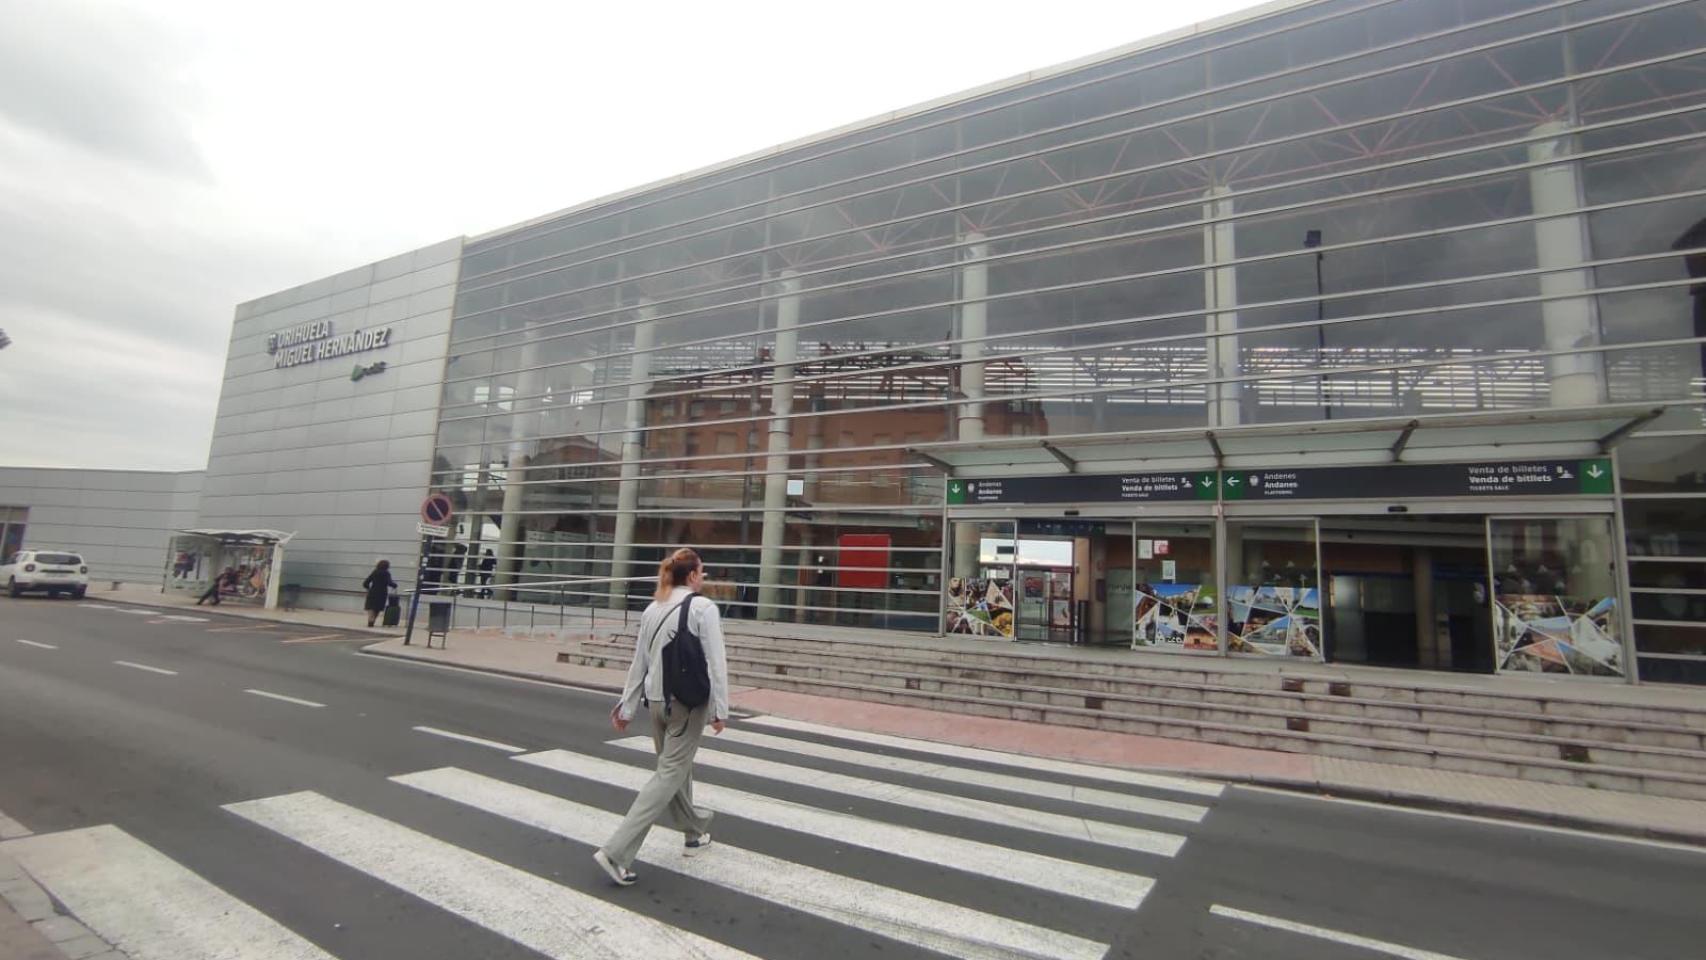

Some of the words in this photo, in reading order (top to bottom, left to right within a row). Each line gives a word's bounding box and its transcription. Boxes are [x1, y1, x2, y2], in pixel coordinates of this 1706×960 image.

[277, 319, 331, 348] ORIHUELA
[273, 344, 314, 368] MIGUEL
[317, 327, 391, 359] HERNÁNDEZ
[1468, 466, 1494, 474] Venta
[1512, 465, 1547, 473] billetes
[1469, 475, 1499, 483] Venda
[1501, 475, 1514, 483] de
[1516, 474, 1552, 482] bitllets
